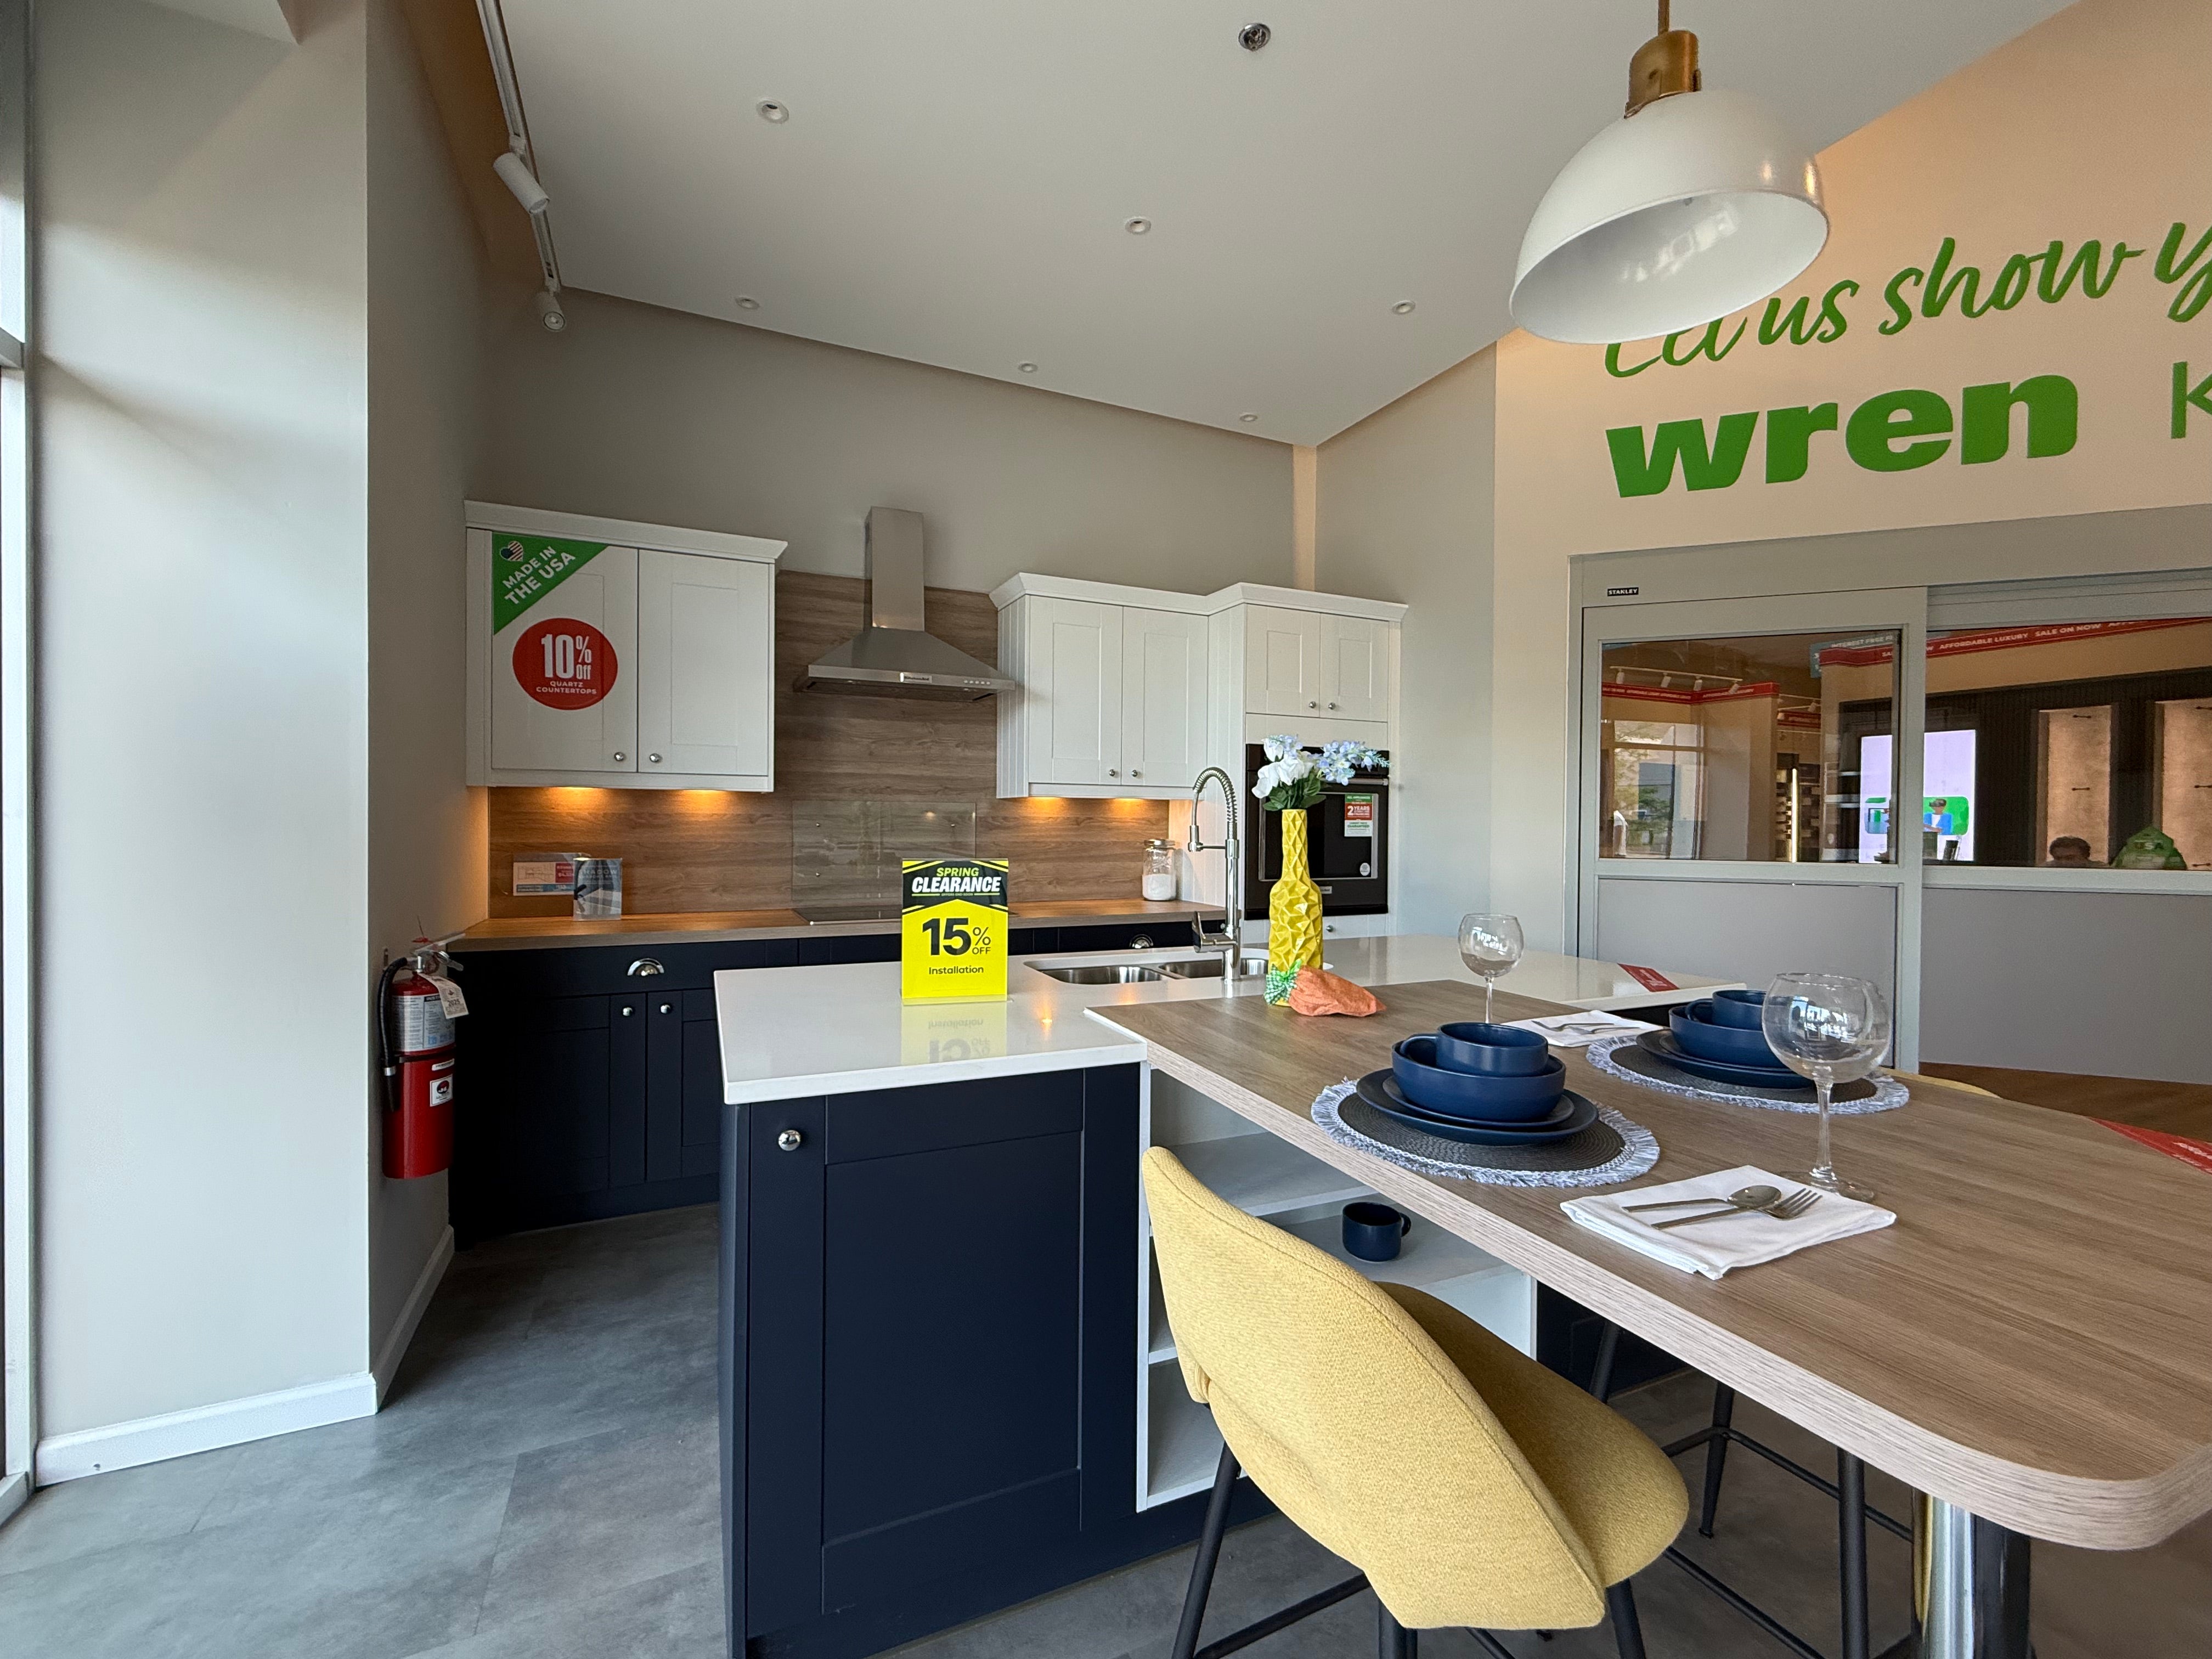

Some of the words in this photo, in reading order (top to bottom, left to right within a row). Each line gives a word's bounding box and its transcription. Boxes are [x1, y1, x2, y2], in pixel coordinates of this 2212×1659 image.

[1758, 280, 1860, 346] us
[1878, 237, 2146, 336] show
[1605, 374, 2078, 498] wren
[503, 557, 541, 589] MADE
[539, 546, 556, 561] IN
[504, 576, 541, 604] THE
[538, 552, 576, 579] USA
[1939, 637, 1993, 650] AFFORDABLE
[1995, 633, 2028, 642] LUXURY
[2035, 629, 2058, 637] SALE
[2076, 623, 2101, 631] NOW
[541, 634, 592, 679] 10%
[1347, 805, 1354, 816] 2
[912, 876, 1002, 893] CLEARANCE
[936, 867, 979, 877] SPRING
[922, 917, 991, 956] 15%
[929, 965, 984, 974] Installation
